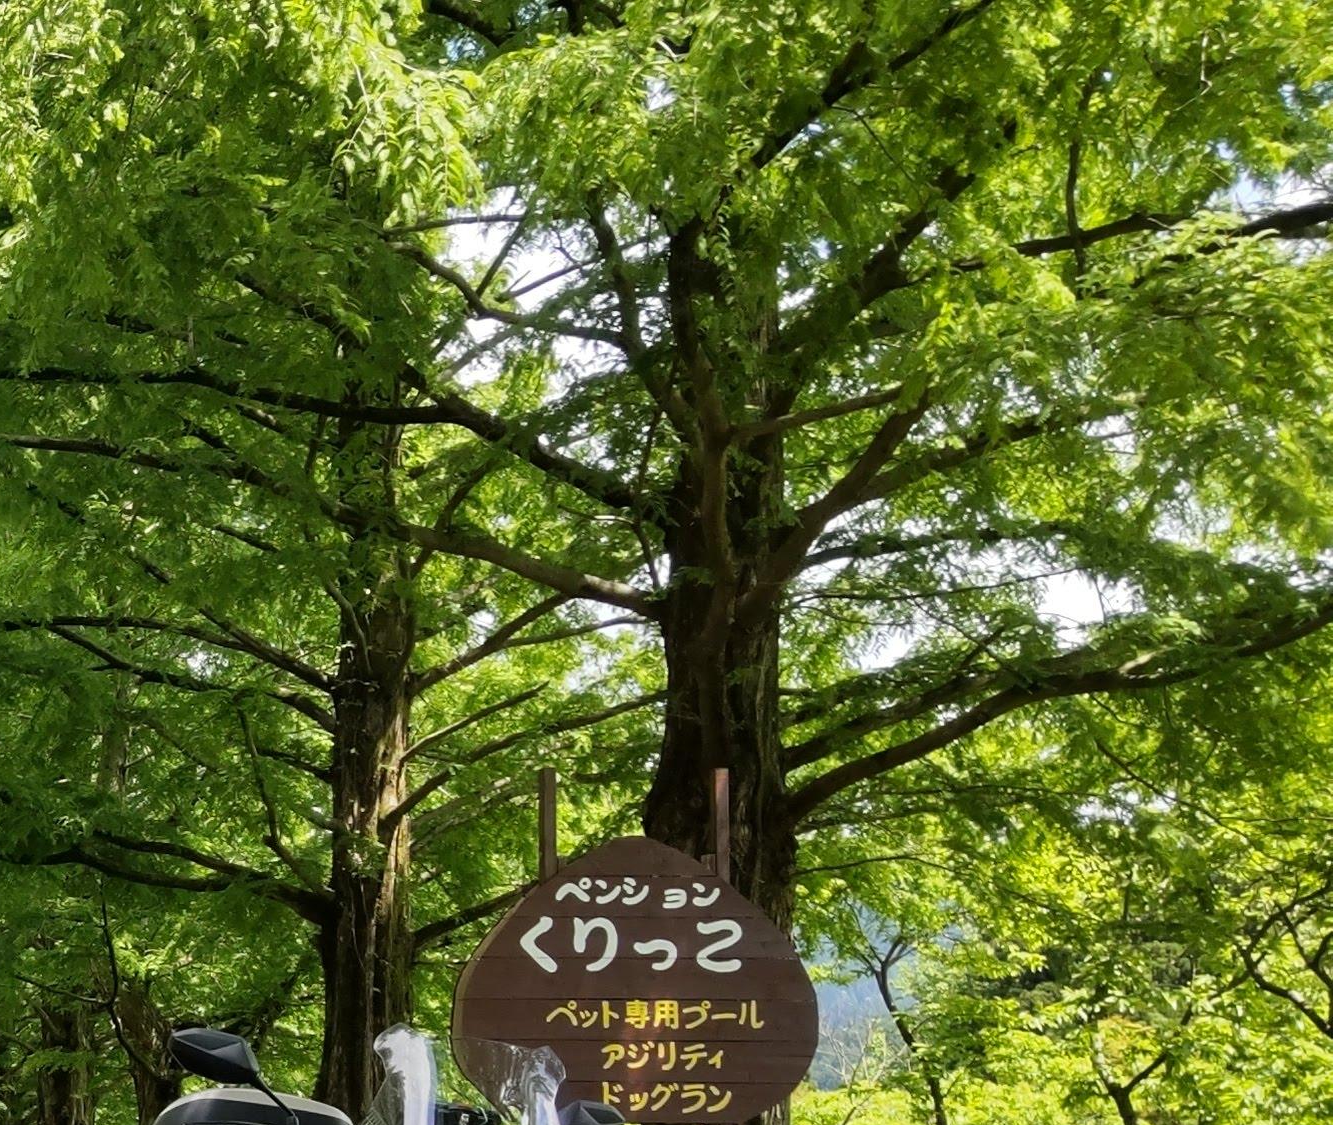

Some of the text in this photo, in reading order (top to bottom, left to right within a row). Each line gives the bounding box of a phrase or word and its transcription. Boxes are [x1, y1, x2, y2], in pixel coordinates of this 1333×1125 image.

[555, 876, 721, 909] ペンション
[519, 915, 743, 973] くりっこ
[546, 1000, 764, 1029] ペット専用プール
[601, 1041, 724, 1070] アジリティ
[602, 1081, 732, 1113] ドッグラン
